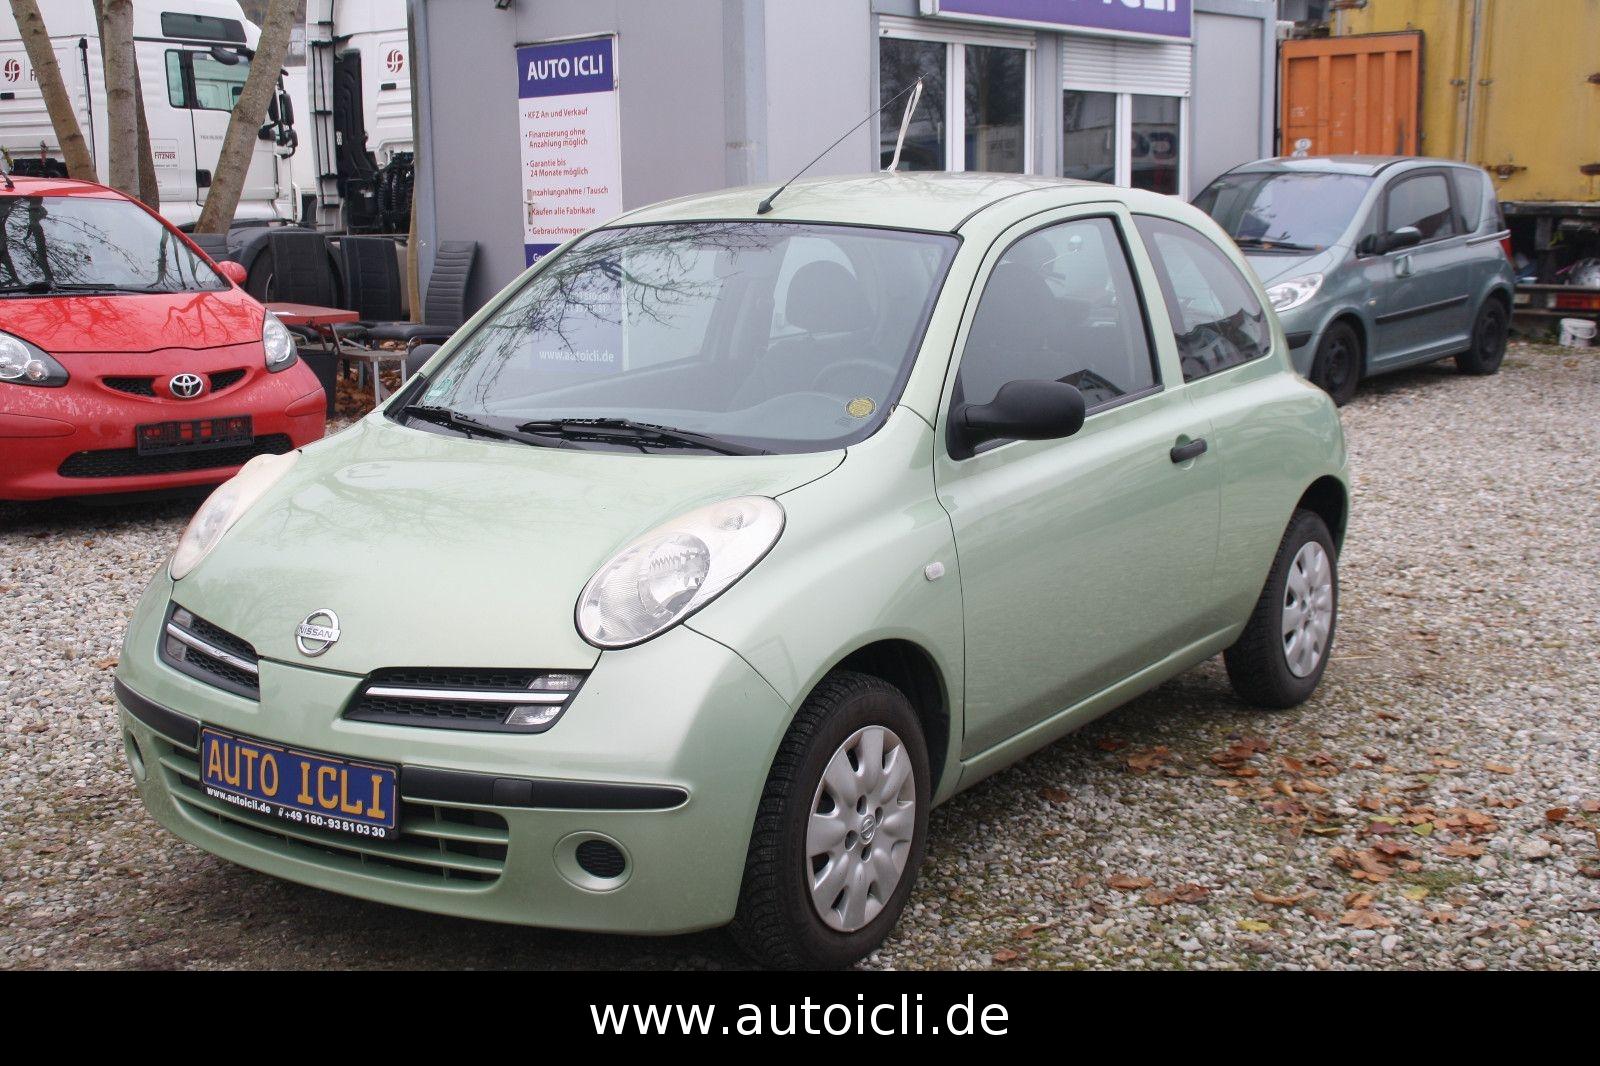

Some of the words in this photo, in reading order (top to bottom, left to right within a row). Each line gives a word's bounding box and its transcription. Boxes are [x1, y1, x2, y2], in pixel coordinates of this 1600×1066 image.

[527, 57, 570, 81] AUTO
[574, 54, 604, 77] ICLI
[551, 108, 563, 118] und
[564, 107, 588, 117] Verkauf
[528, 129, 569, 138] Finanzierung
[569, 128, 586, 136] ohne
[529, 139, 562, 149] Anzahlung
[562, 137, 588, 148] möglich
[530, 160, 556, 168] Garantie
[556, 158, 567, 166] bis
[530, 169, 538, 177] 24
[538, 167, 562, 177] Monate
[563, 167, 589, 177] möglich
[530, 186, 582, 198] nzahlungnahme
[587, 186, 609, 195] Tausch
[532, 207, 553, 216] Kaufen
[554, 206, 565, 215] alle
[566, 205, 596, 215] Fabrikate
[300, 625, 333, 639] NISSAN
[207, 739, 279, 797] AUTO
[297, 761, 386, 820] ICLI
[206, 786, 271, 814] www.autoicli.de
[284, 810, 302, 821] +49
[371, 826, 386, 838] 30
